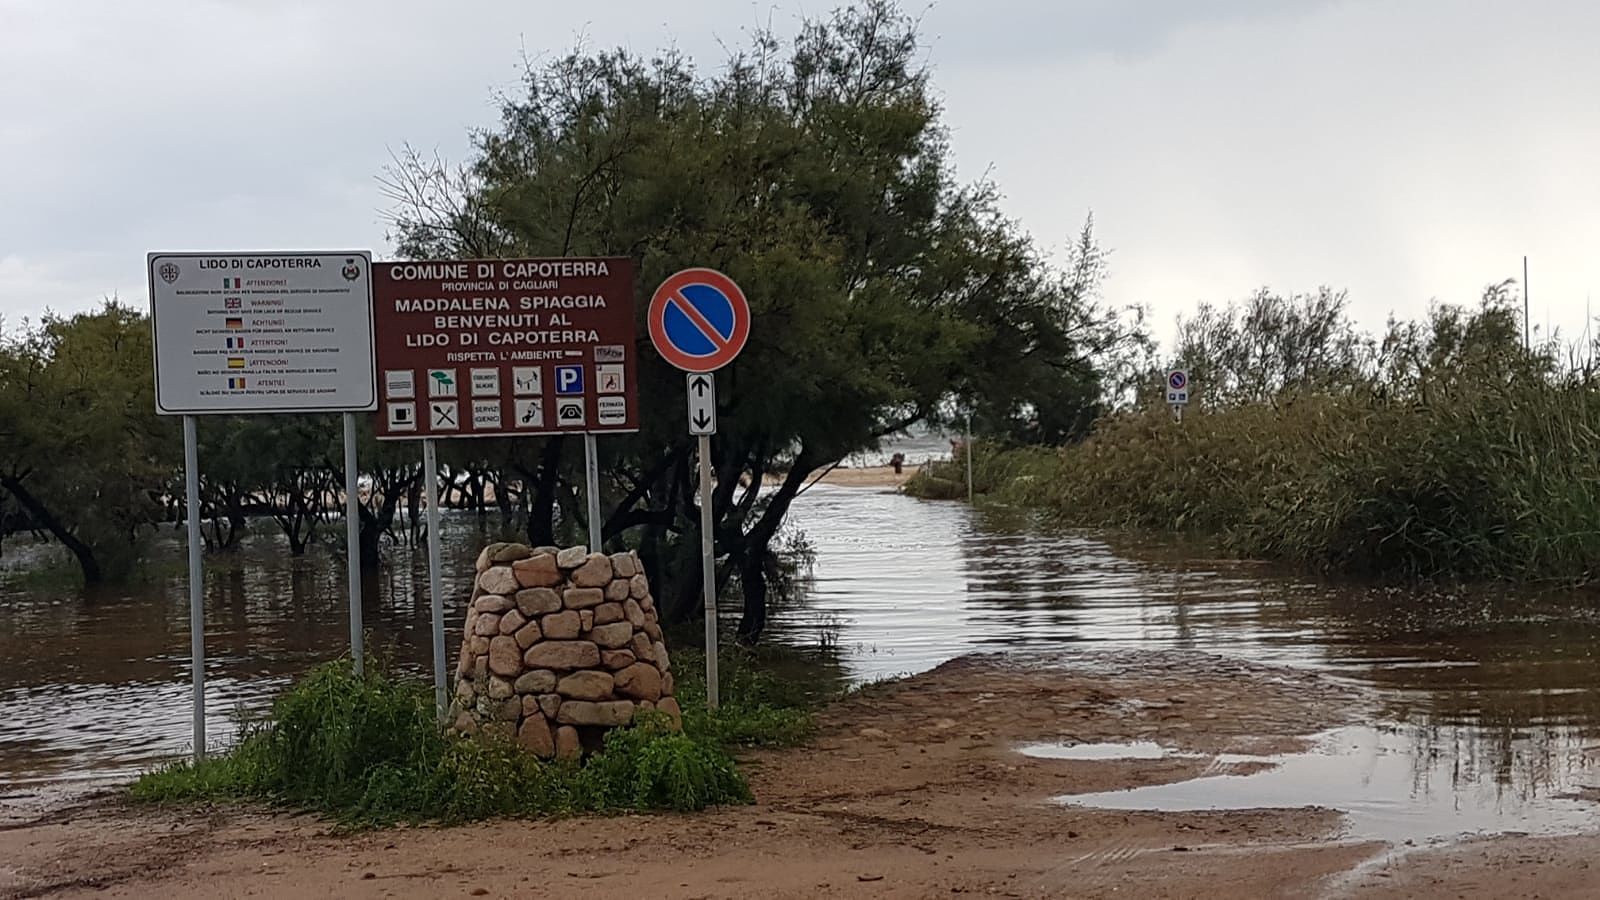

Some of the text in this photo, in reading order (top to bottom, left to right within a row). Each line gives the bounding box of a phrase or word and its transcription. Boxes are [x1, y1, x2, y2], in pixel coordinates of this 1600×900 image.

[200, 259, 321, 269] LIDO DI CAPOTERRA
[391, 262, 609, 280] COMUNE DI CAPOTERRA
[442, 280, 558, 291] PROVINCIA DI CAGLIARI
[395, 295, 606, 312] MADDALENA SPIAGGIA
[435, 314, 572, 329] BENVENUTI AL
[406, 330, 599, 347] LIDO DI CAPOTERRA
[447, 352, 496, 362] RISPETTA
[560, 368, 578, 391] P
